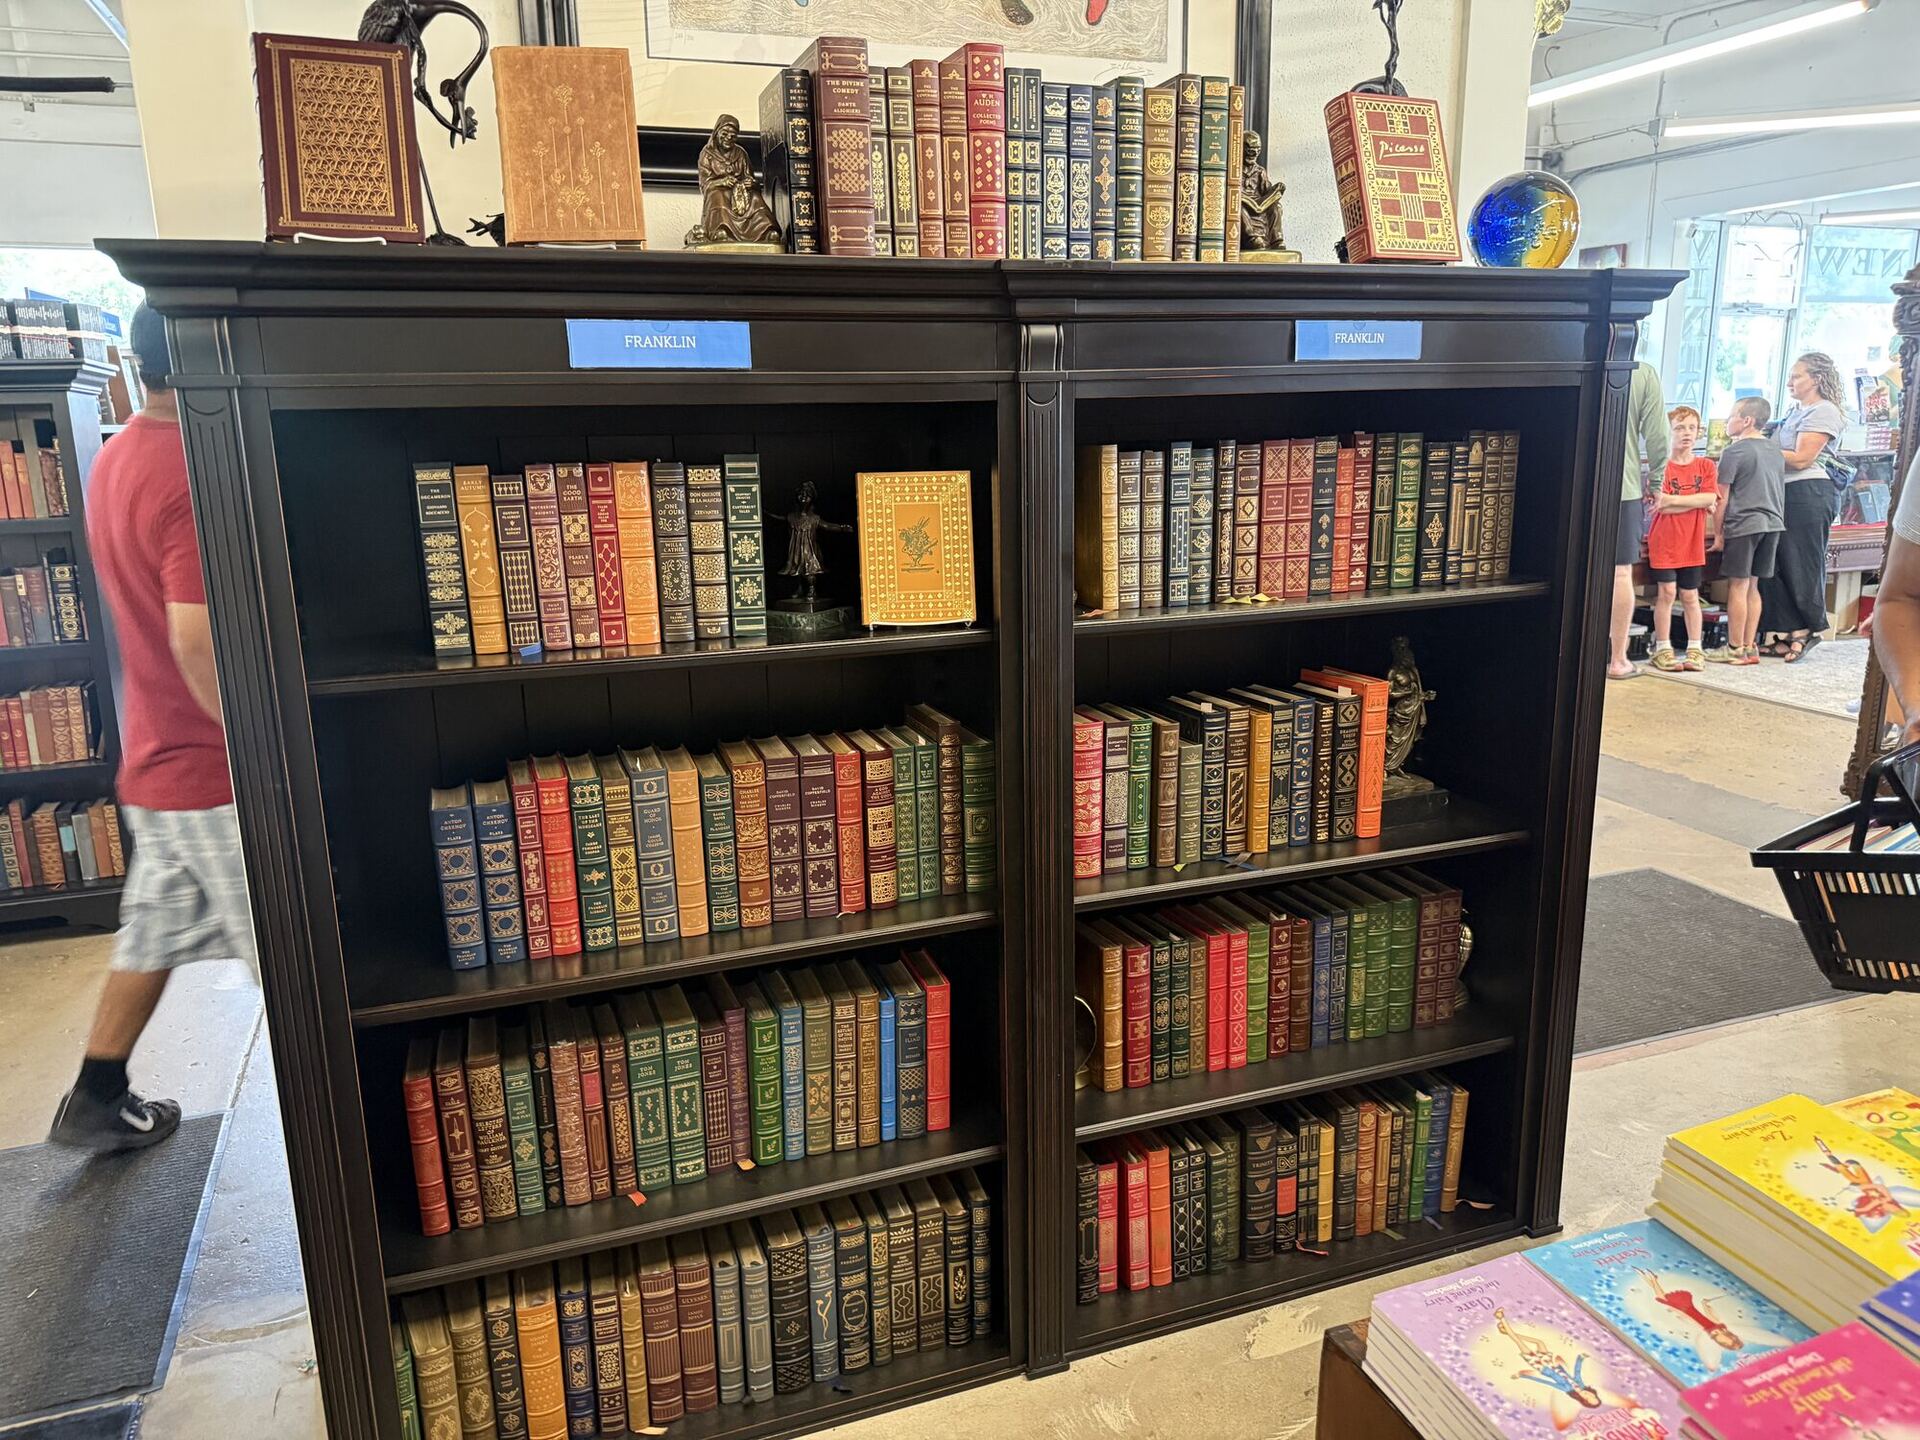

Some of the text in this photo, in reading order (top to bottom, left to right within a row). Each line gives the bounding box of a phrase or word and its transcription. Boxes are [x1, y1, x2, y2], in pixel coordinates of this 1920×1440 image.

[625, 335, 696, 348] FRANKLIN
[1334, 333, 1384, 343] FRANKLIN
[675, 1063, 693, 1072] JONES
[638, 1070, 656, 1078] JONES
[476, 1118, 503, 1127] SELECTED
[478, 1136, 506, 1145] FAULKNER
[1761, 1130, 1793, 1142] Zoe
[1252, 1160, 1273, 1168] TRINITY
[1570, 1232, 1628, 1250] Daisy Meadows
[1594, 1247, 1649, 1266] Scarlett
[1423, 1275, 1484, 1297] Daisy Meadows
[1425, 1279, 1500, 1307] the Caring Fairy
[682, 1295, 708, 1304] ULYSSES
[1457, 1296, 1495, 1313] Clare
[647, 1304, 673, 1314] ULYSSES
[457, 1351, 483, 1362] HENRIK
[462, 1369, 484, 1377] PLAYS
[1742, 1352, 1825, 1388] Daisy Meadows
[424, 1376, 450, 1387] HENRIK
[427, 1384, 449, 1392] IBSEN
[1790, 1383, 1856, 1416] Emily
